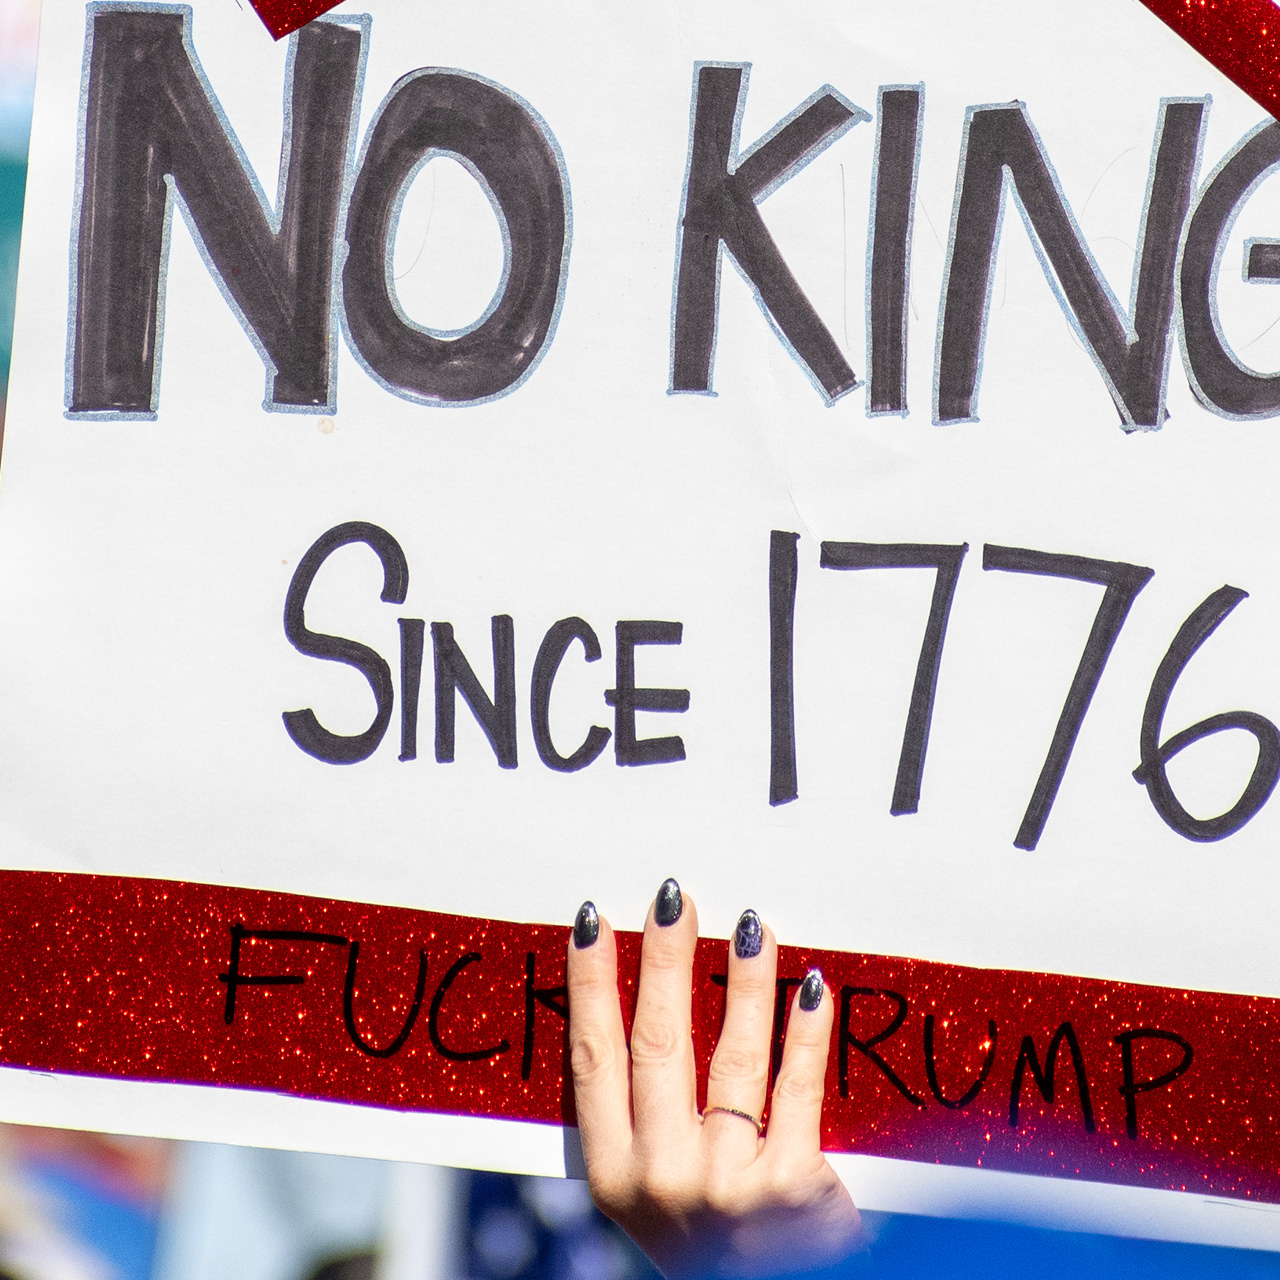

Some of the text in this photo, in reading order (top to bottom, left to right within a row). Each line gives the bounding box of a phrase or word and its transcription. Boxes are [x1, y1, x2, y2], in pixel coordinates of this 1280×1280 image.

[64, 1, 573, 422] NO
[282, 521, 690, 772] SINCE
[710, 972, 1195, 1140] TRUMP
